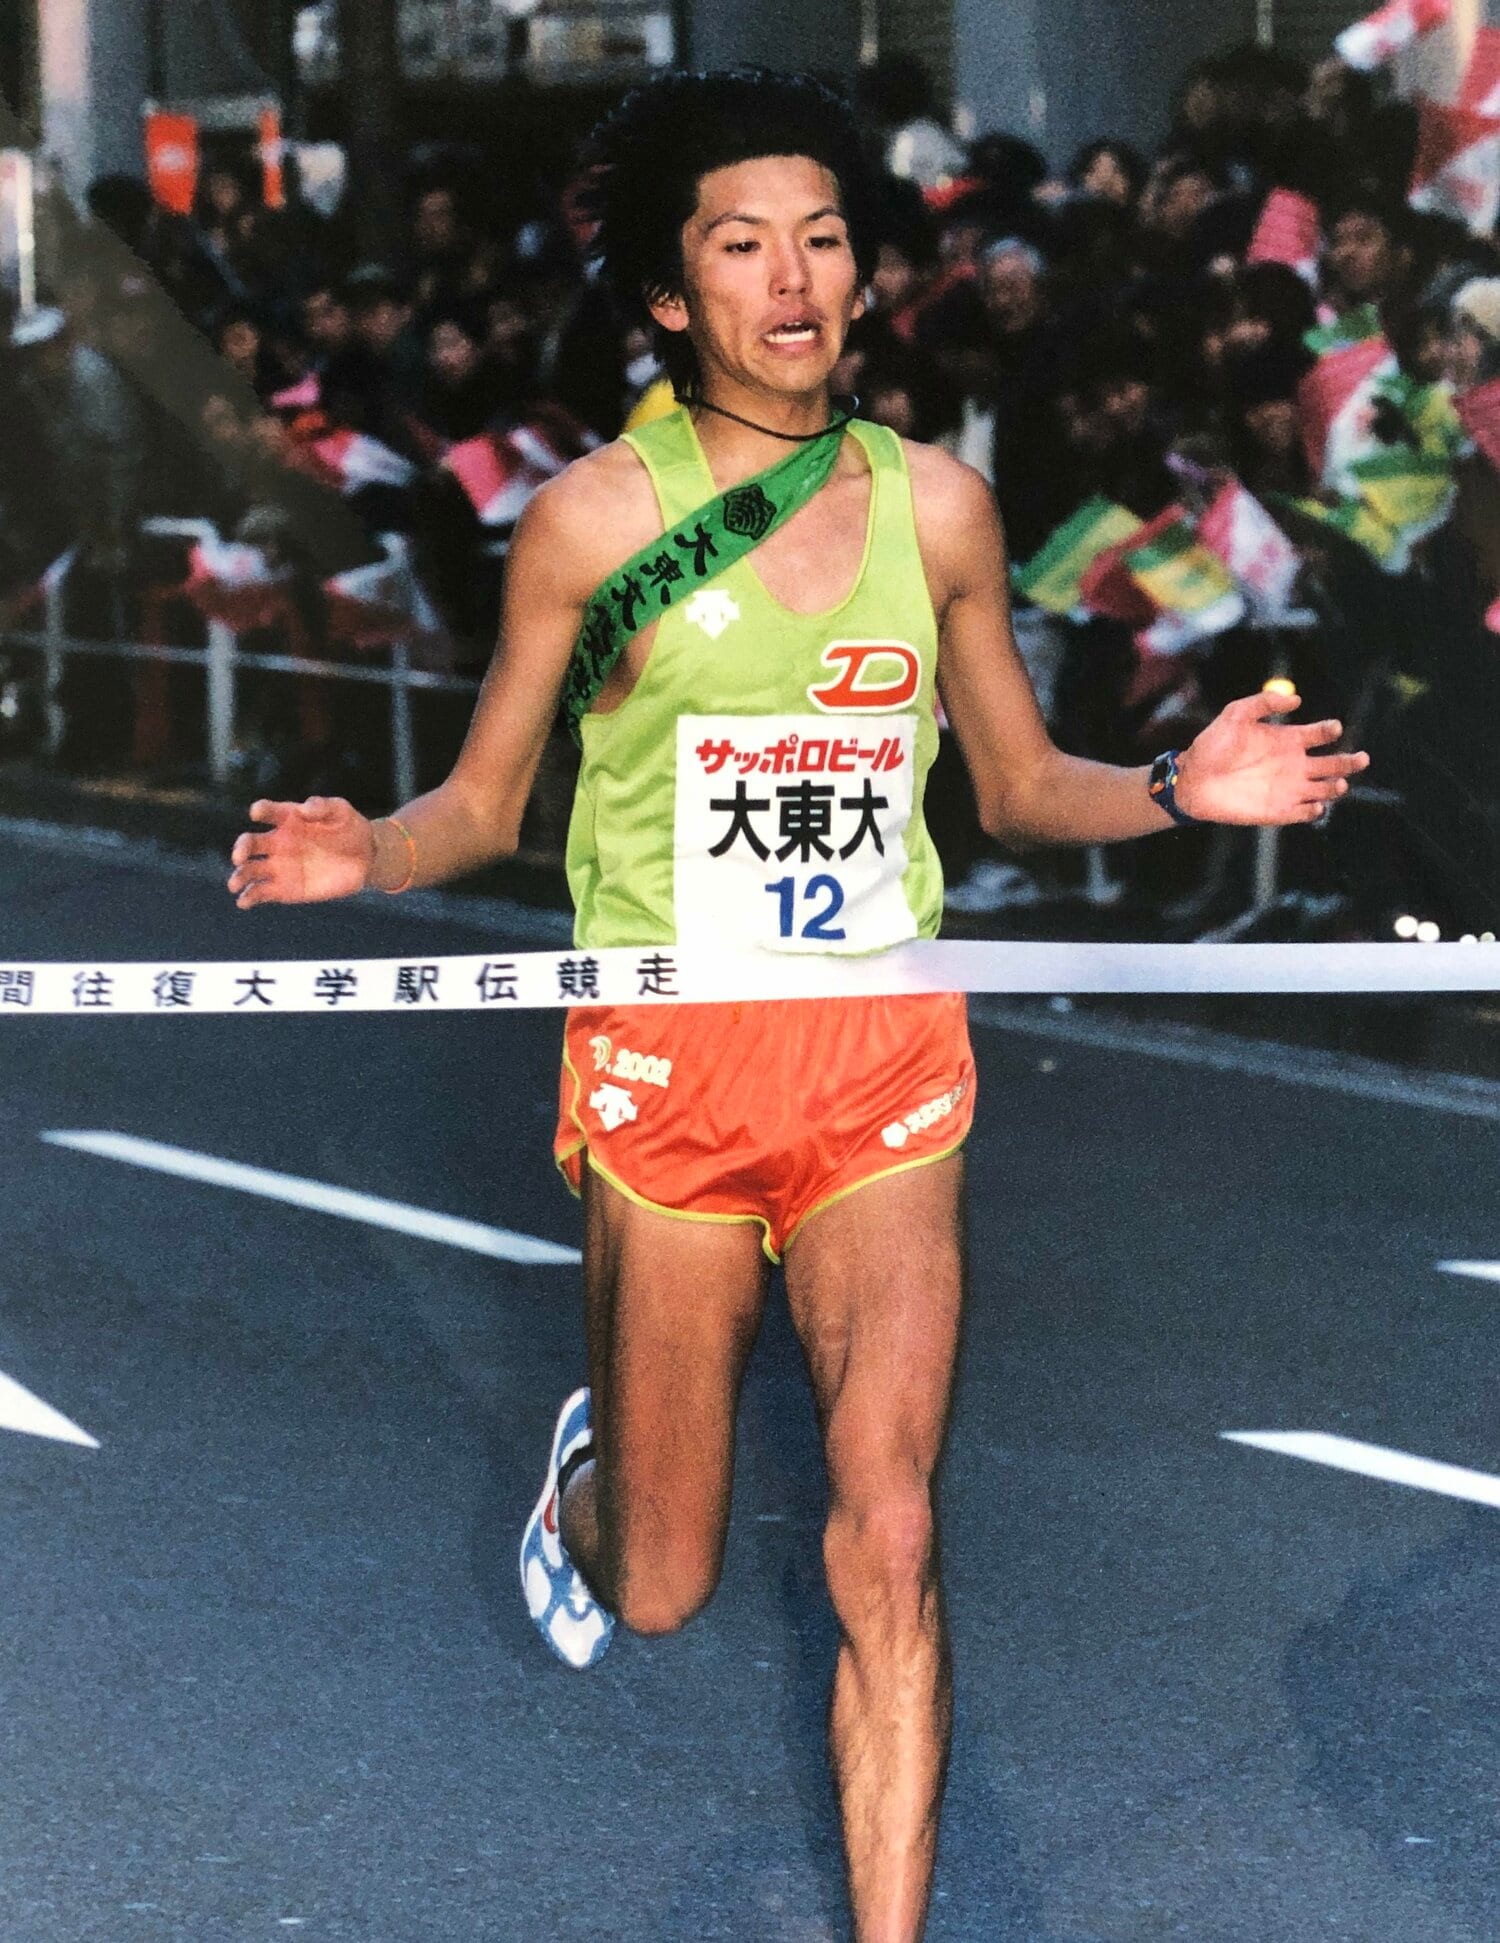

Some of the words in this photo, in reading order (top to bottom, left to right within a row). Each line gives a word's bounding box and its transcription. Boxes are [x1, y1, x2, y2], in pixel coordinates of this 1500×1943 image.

[695, 733, 905, 775] サッポロビール
[707, 777, 890, 864] 大東大
[764, 872, 847, 941] 12
